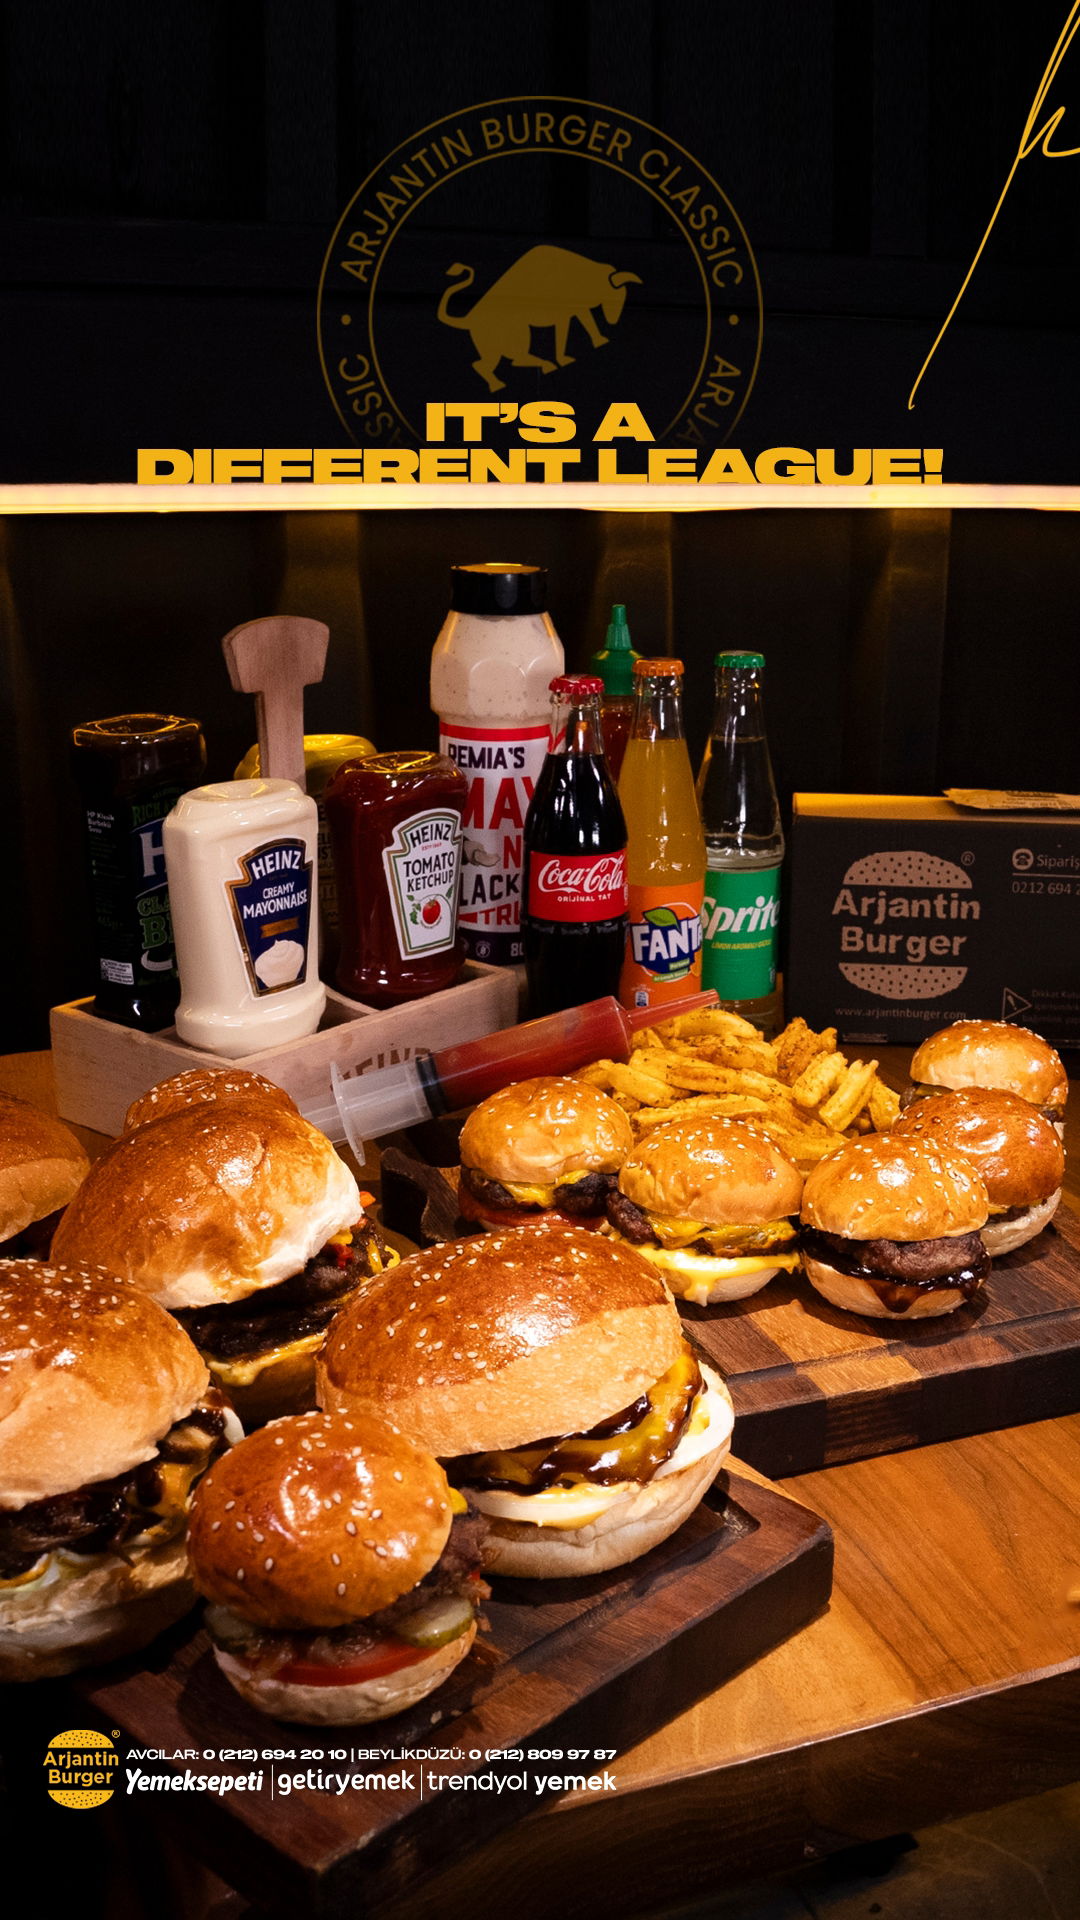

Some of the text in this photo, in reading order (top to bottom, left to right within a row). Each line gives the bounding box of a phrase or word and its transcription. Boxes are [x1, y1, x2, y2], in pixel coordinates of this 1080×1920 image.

[409, 823, 452, 849] HEINZ
[251, 850, 302, 880] HEINZ
[403, 851, 455, 877] TOMATO
[537, 855, 625, 894] Coca-Cola
[262, 881, 295, 899] CREAMY
[407, 869, 454, 893] KETCHUP
[1011, 880, 1045, 894] 0212
[1047, 881, 1072, 895] 694
[242, 889, 308, 919] MAYONNAISE
[701, 896, 780, 940] Sprite
[831, 887, 981, 925] Arjantin
[840, 926, 968, 963] Burger
